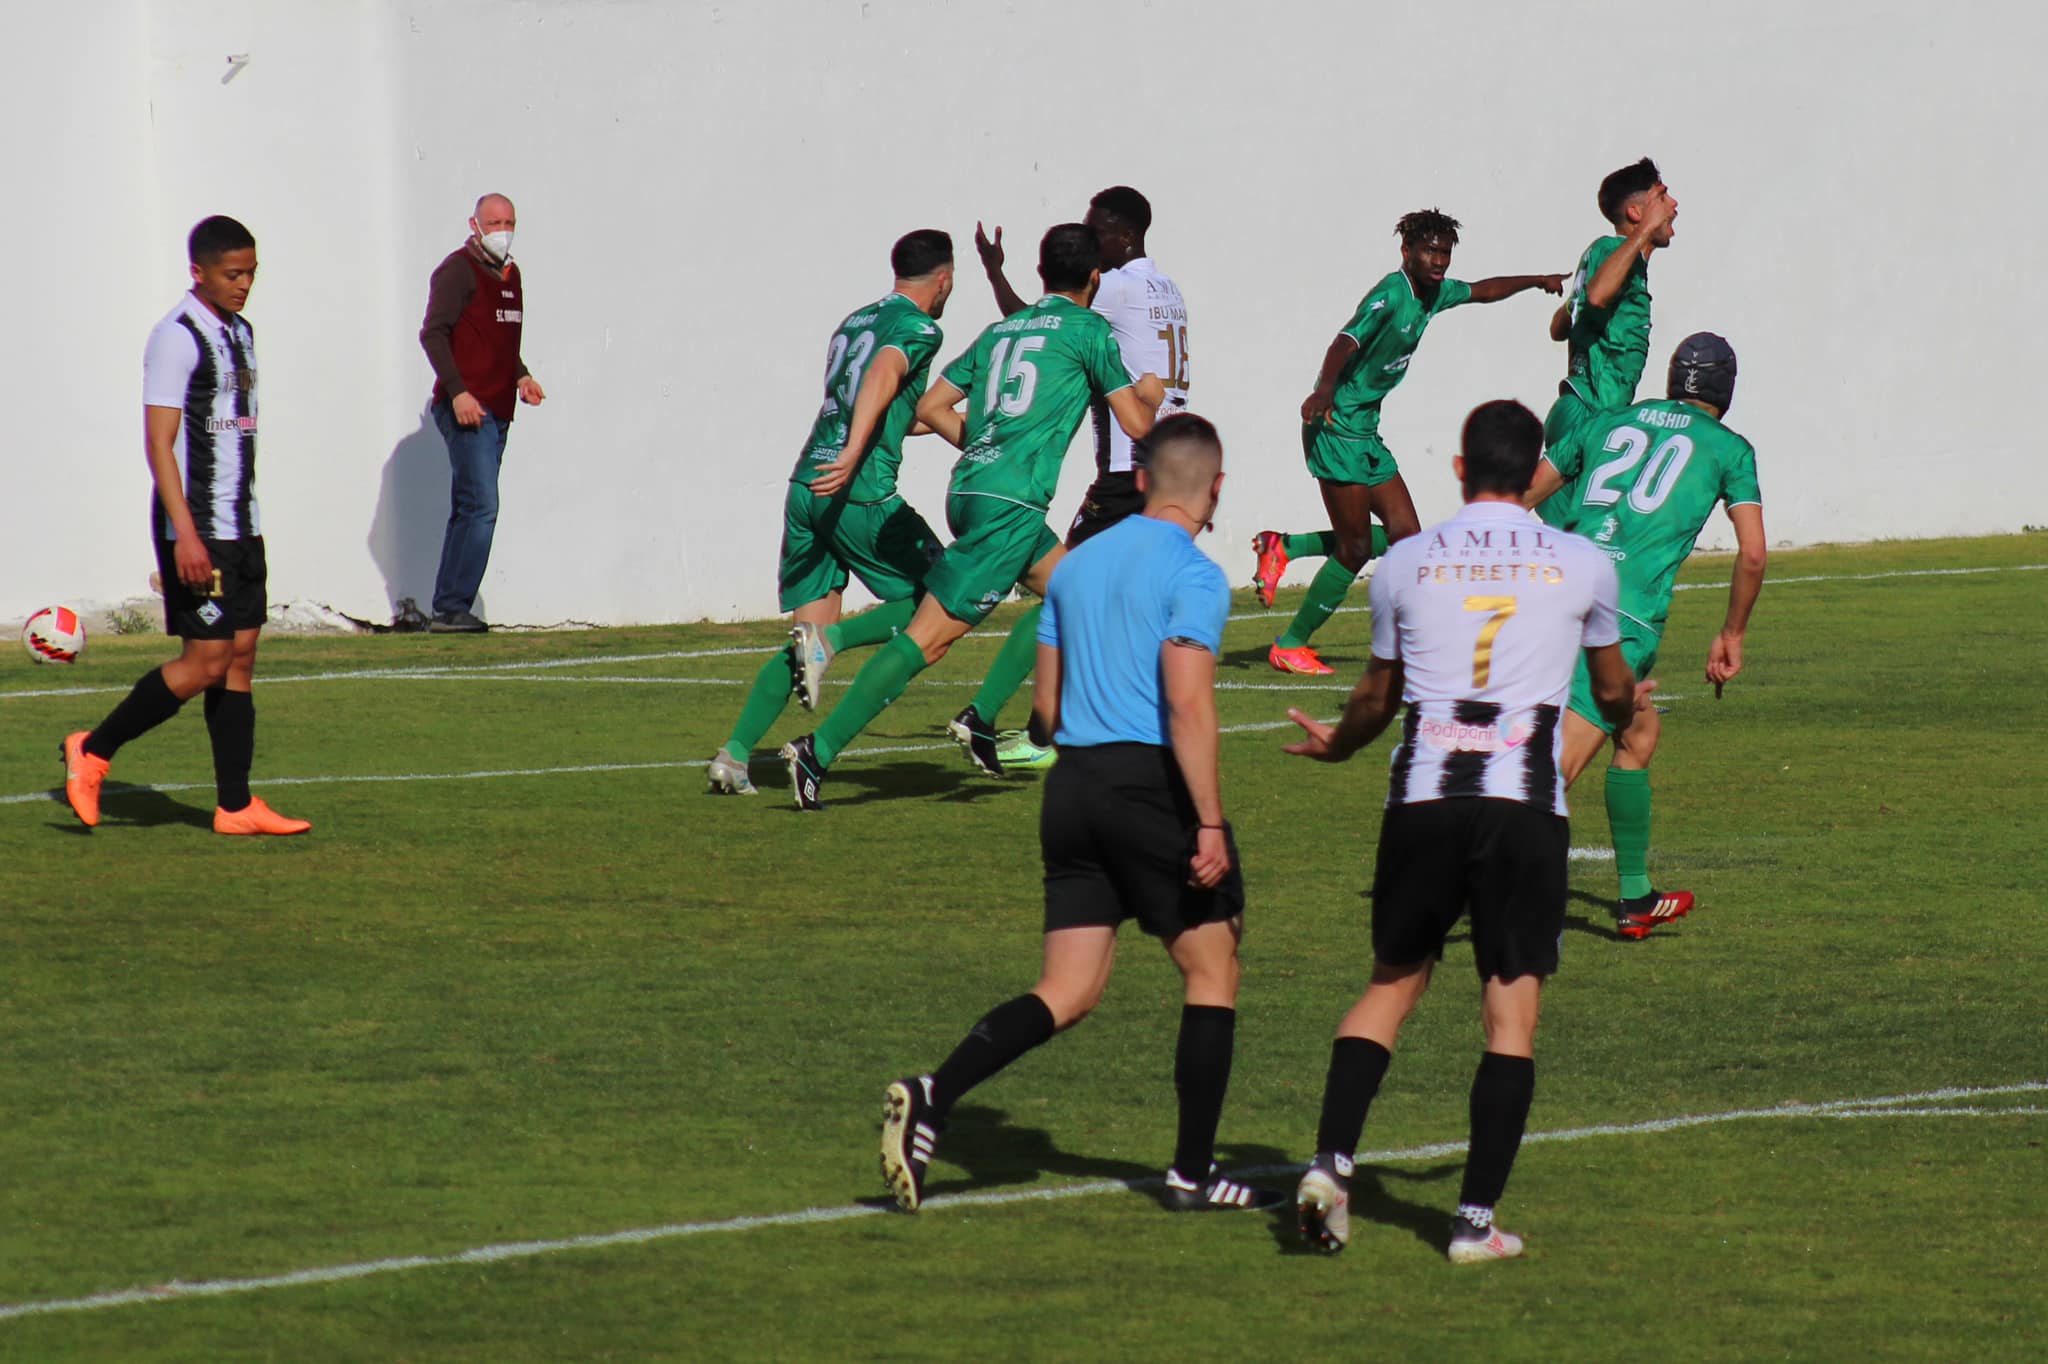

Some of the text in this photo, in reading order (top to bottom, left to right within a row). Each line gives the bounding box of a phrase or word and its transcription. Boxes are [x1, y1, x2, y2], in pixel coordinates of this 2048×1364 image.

[1149, 306, 1168, 320] IBU
[824, 331, 875, 417] 23
[984, 336, 1046, 417] 15
[1638, 408, 1691, 429] RASHID
[1582, 426, 1692, 514] 20
[1428, 531, 1553, 550] AMIL
[1463, 596, 1516, 689] 7
